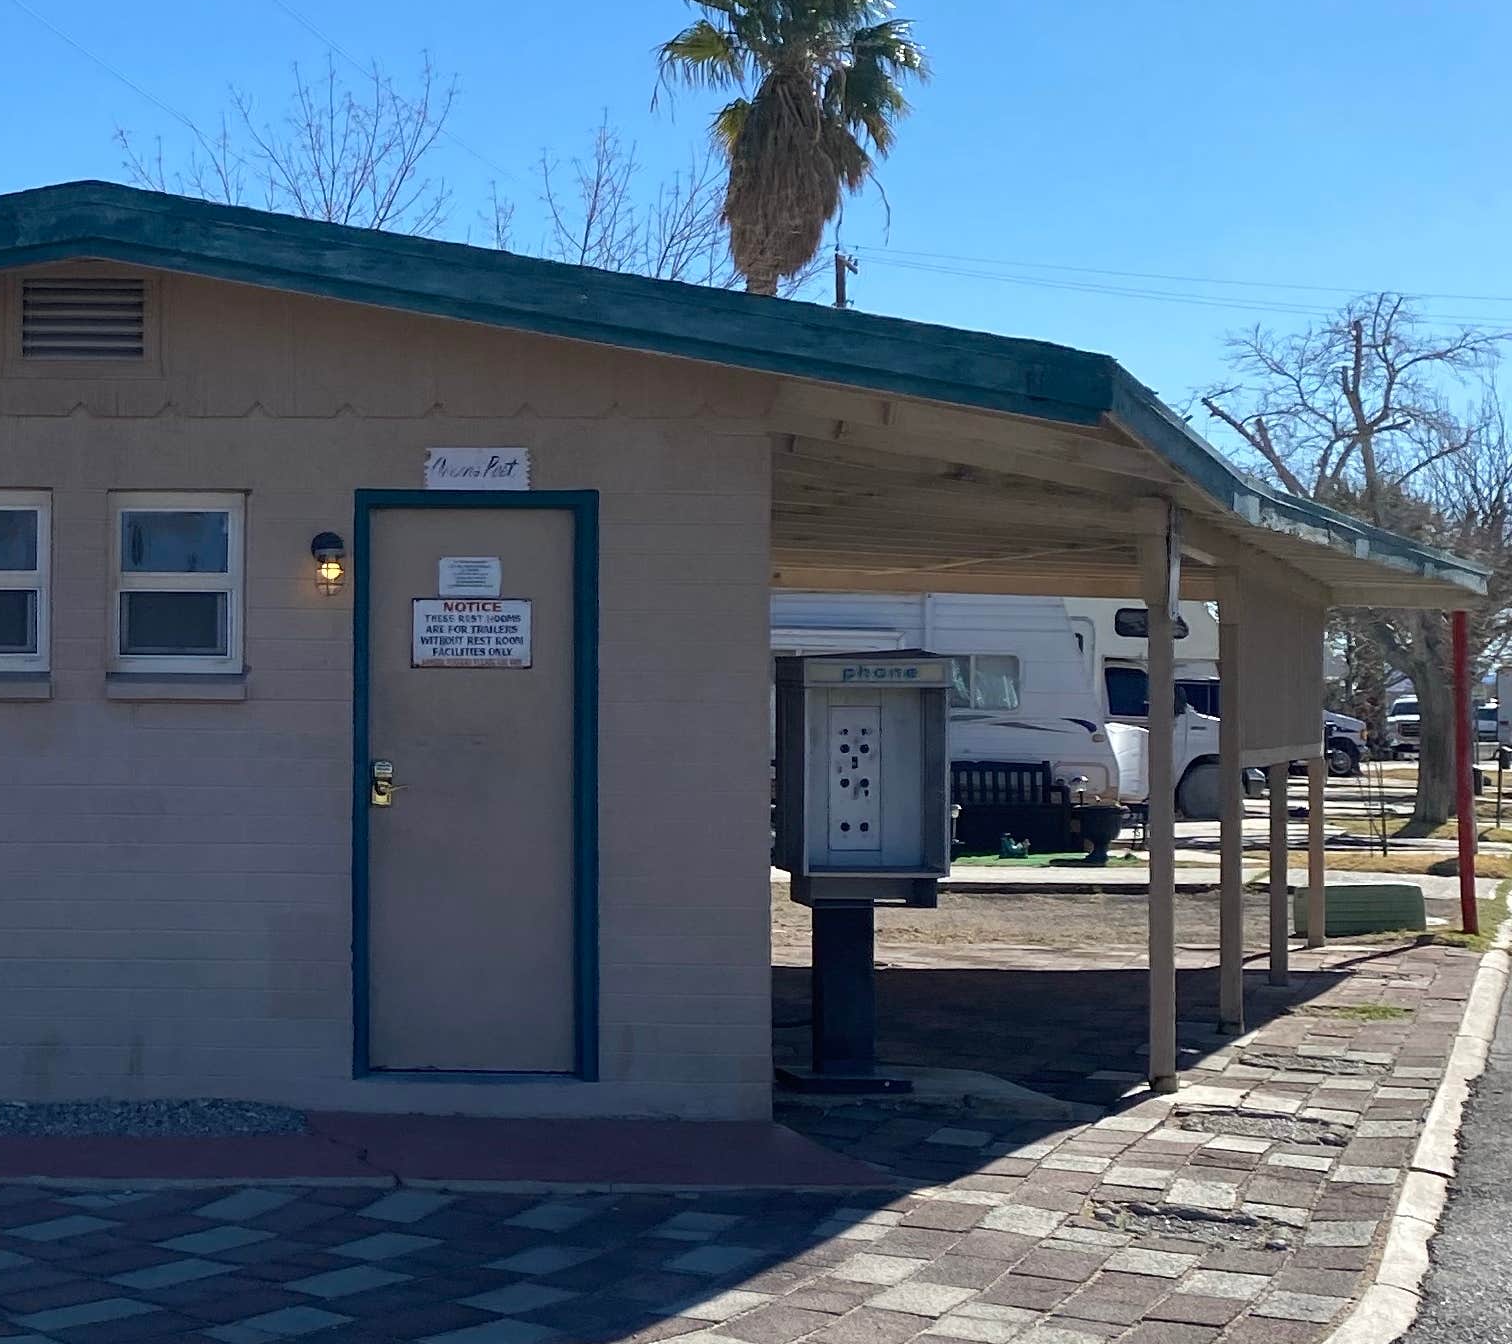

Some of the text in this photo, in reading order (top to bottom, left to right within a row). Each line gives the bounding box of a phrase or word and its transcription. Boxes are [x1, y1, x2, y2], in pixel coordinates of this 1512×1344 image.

[443, 601, 502, 612] NOTICE
[424, 614, 522, 623] THESE REST ROOMS
[425, 625, 518, 634] ARE FOR TRAILERS
[420, 636, 524, 646] WITHOUT REST ROOM
[432, 647, 513, 657] FACILITIES ONLY
[842, 665, 919, 682] phone
